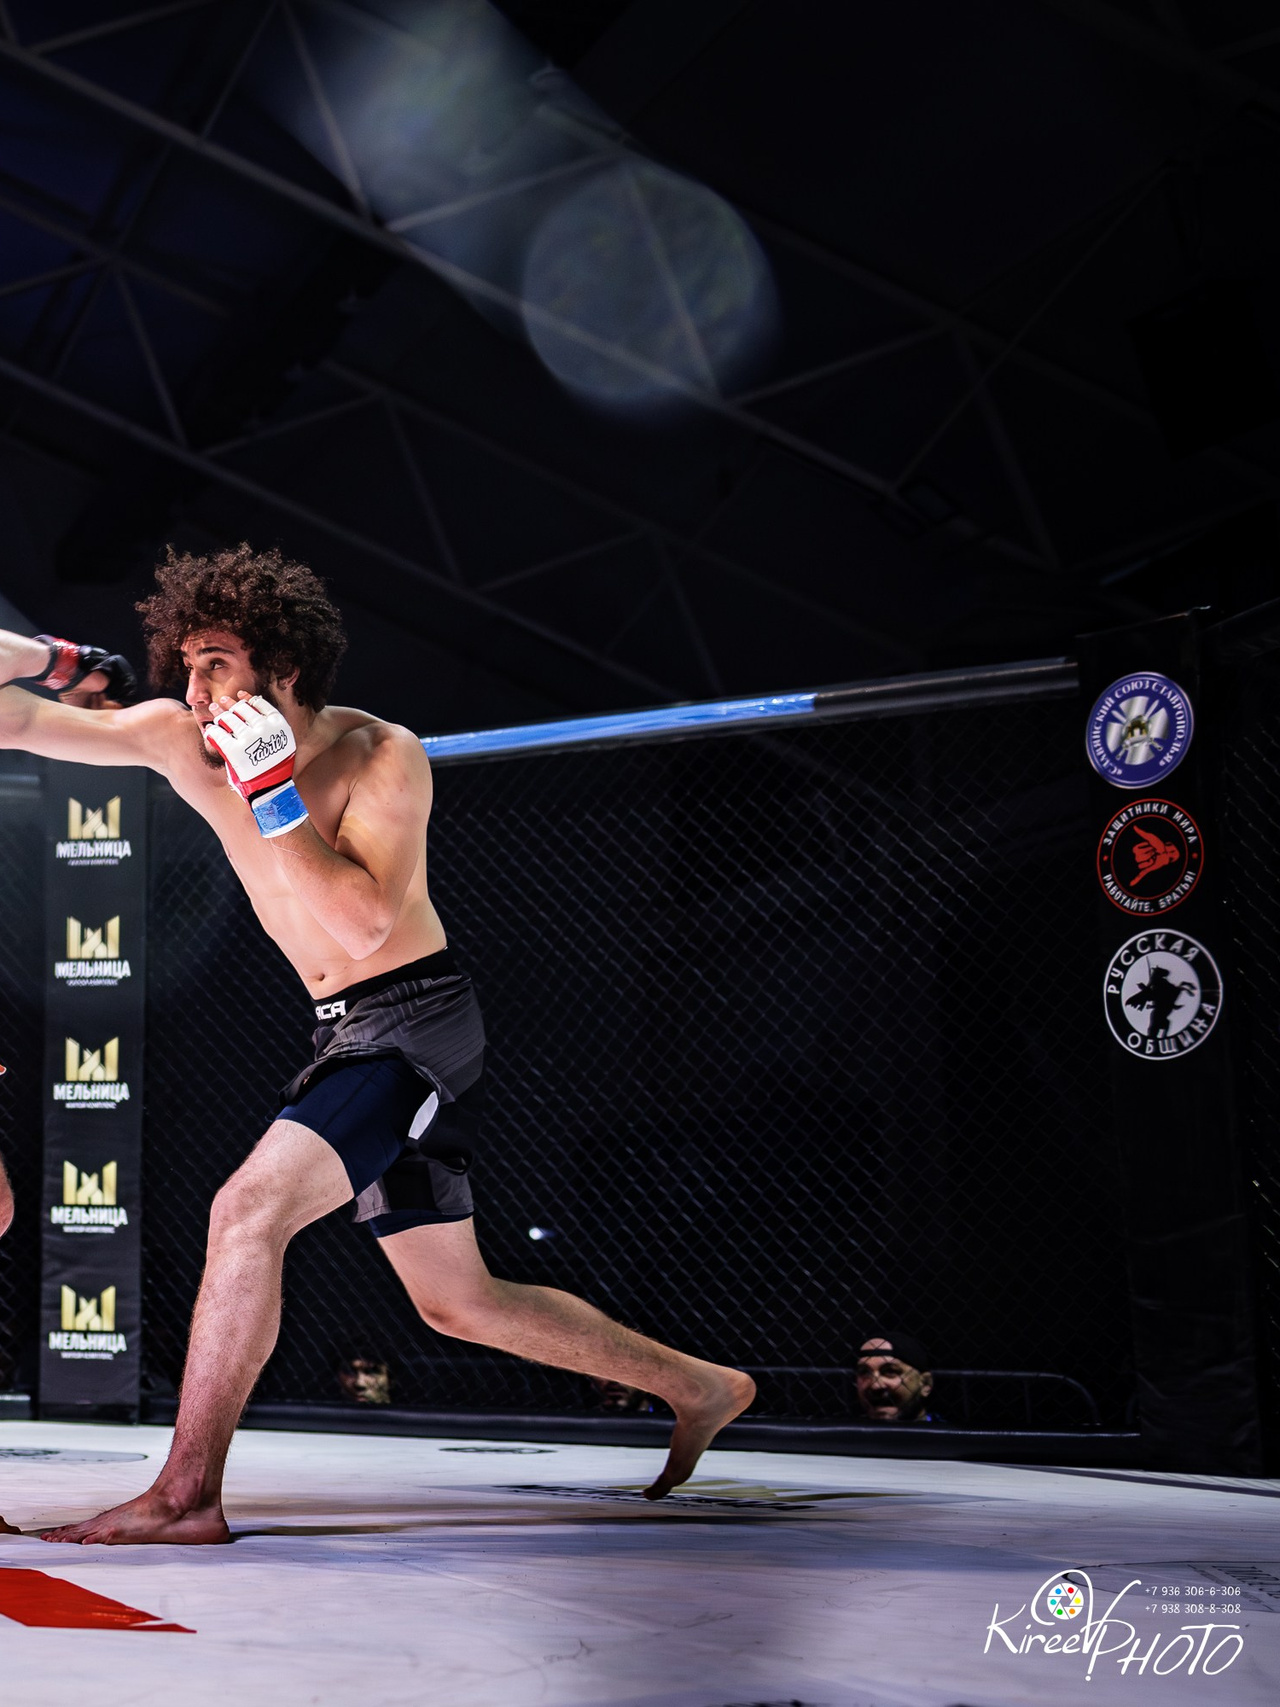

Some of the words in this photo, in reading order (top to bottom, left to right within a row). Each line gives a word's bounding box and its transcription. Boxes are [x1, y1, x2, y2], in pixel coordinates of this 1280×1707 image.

[1115, 680, 1150, 698] СОЮЗ
[245, 729, 288, 766] Fairtex
[1103, 803, 1168, 845] ЗАЩИТНИКИ
[1173, 811, 1197, 843] МИРА
[56, 841, 132, 859] МЕЛЬНИЦА
[1158, 871, 1196, 908] БРАТЬЯ!
[54, 960, 131, 980] МЕЛЬНИЦА
[1107, 934, 1199, 994] РУССКАЯ
[1127, 1002, 1216, 1054] ОБЩИНА
[53, 1083, 130, 1102] МЕЛЬНИЦА
[51, 1206, 128, 1227] МЕЛЬНИЦА
[48, 1331, 127, 1353] МЕЛЬНИЦА
